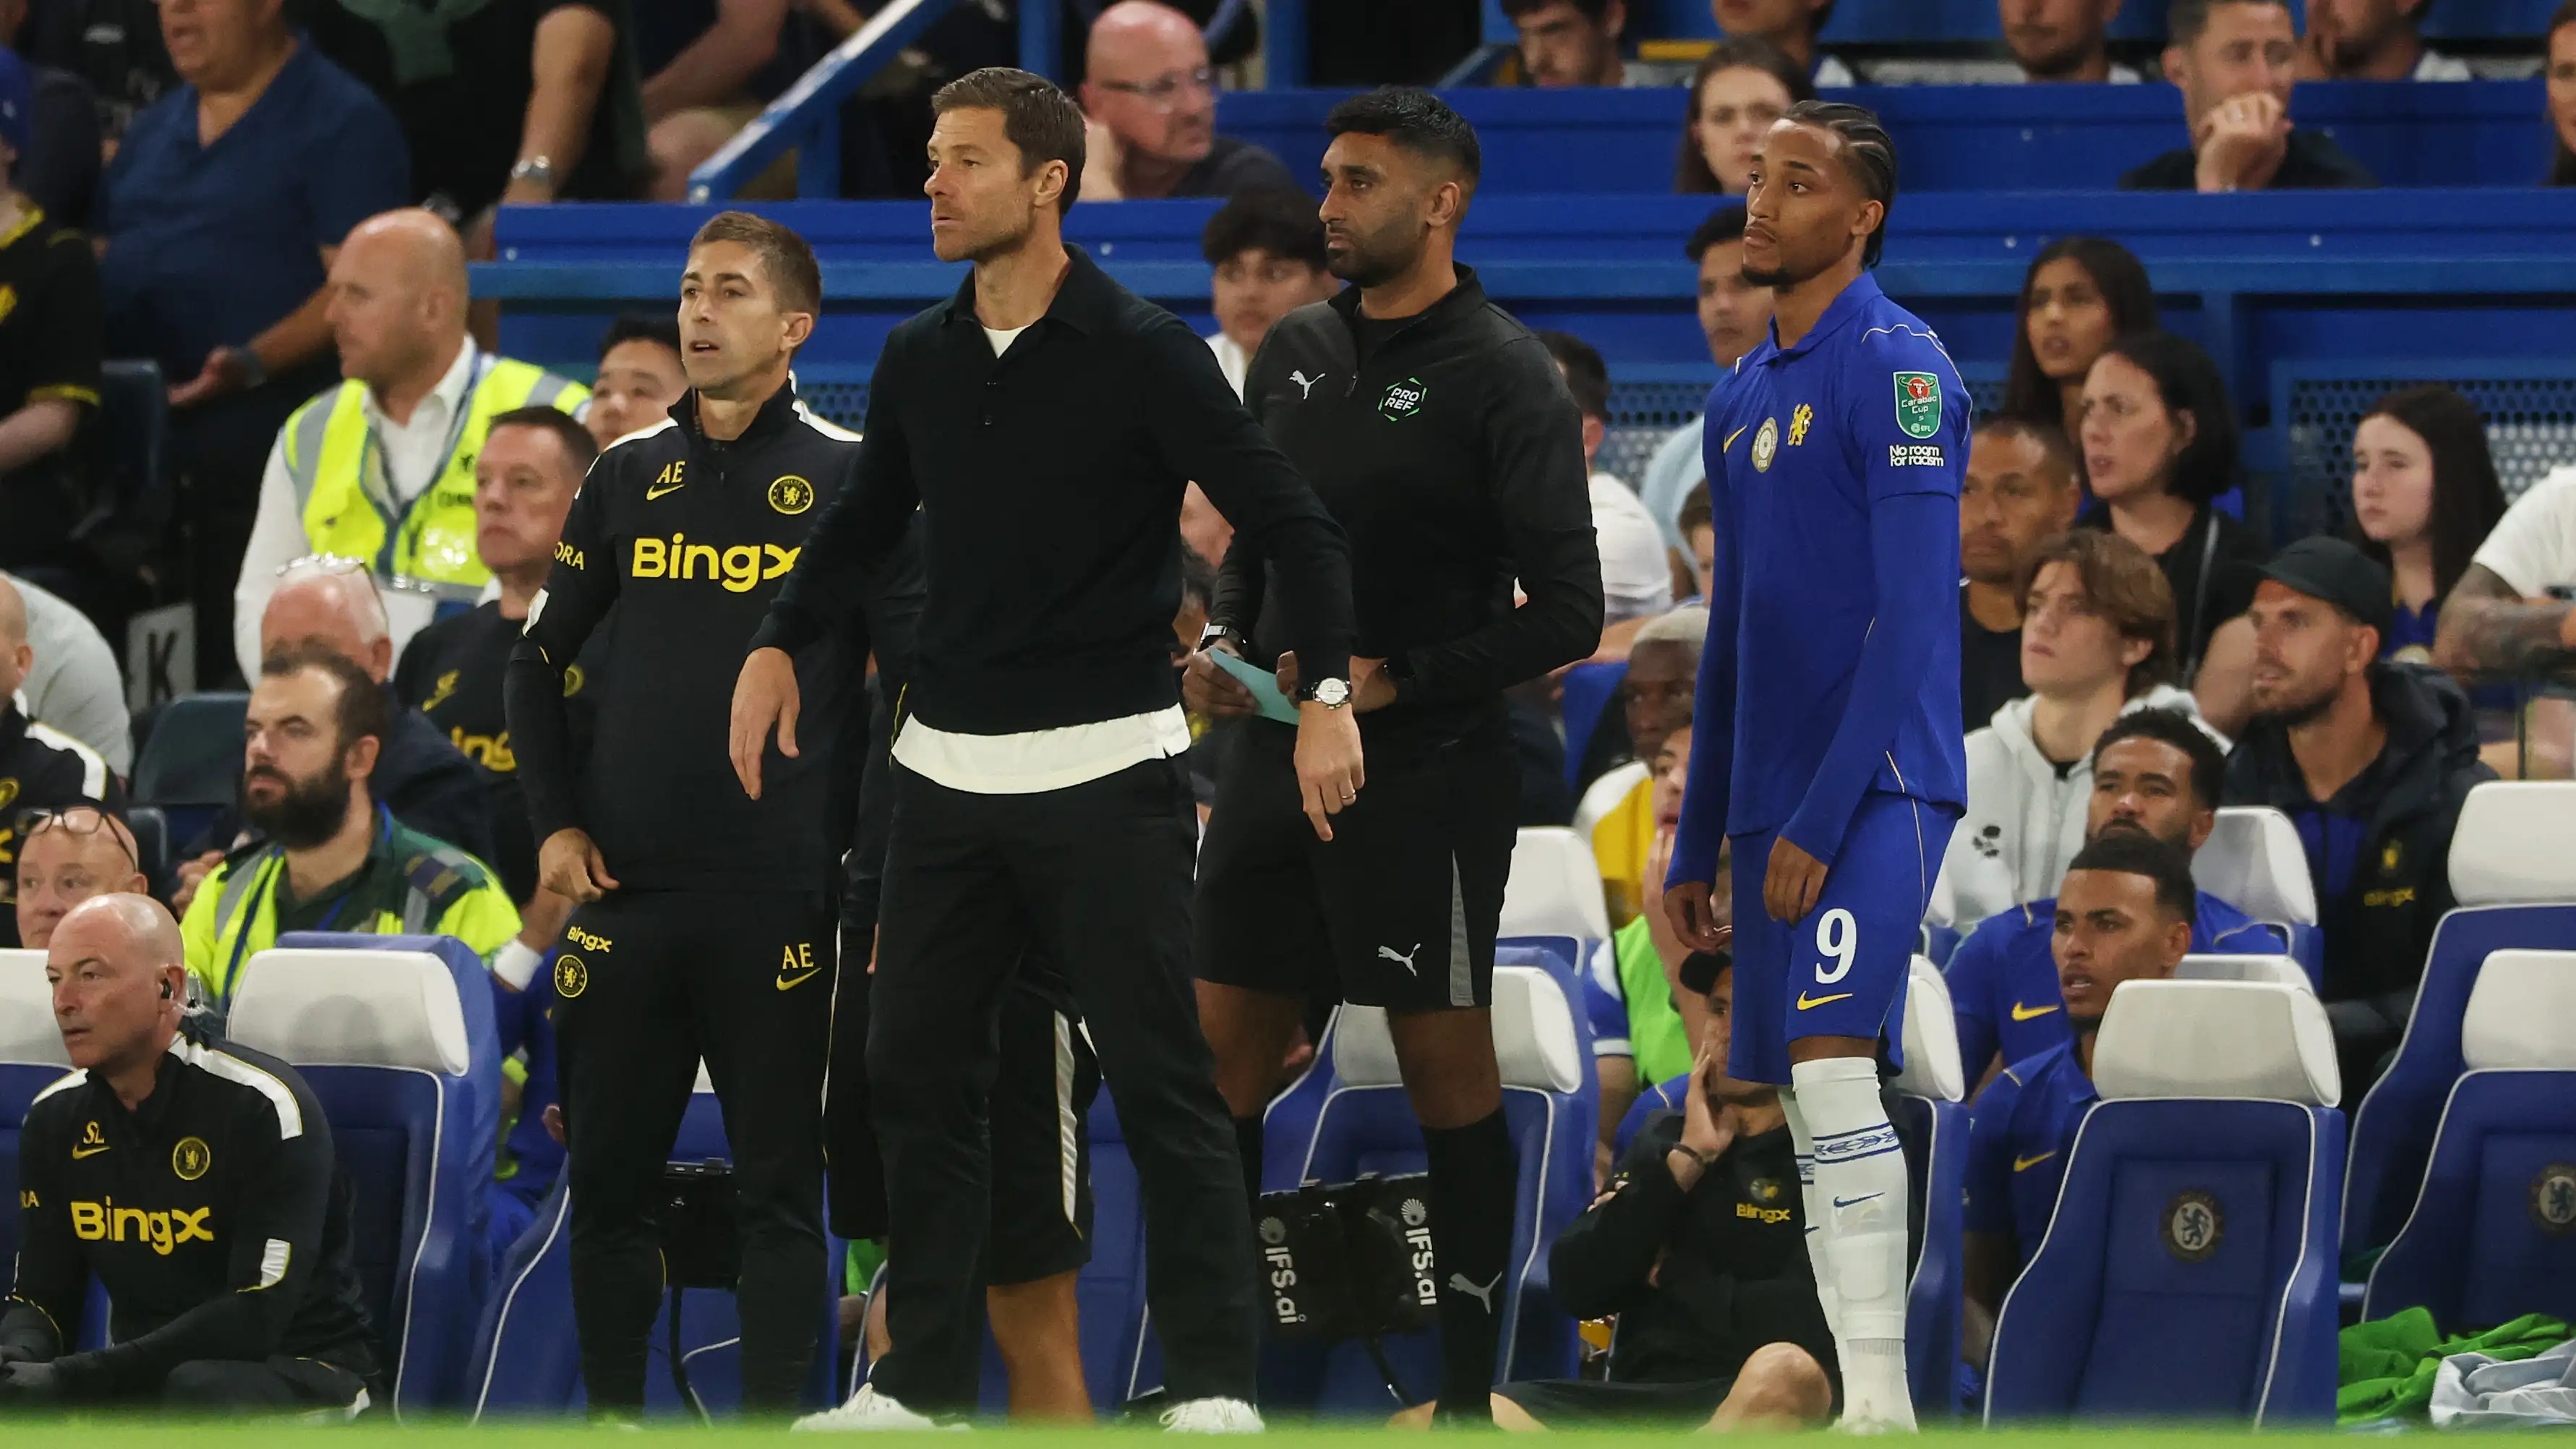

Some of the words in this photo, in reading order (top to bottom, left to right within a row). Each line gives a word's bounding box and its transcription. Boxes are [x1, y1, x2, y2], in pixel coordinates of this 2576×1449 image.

[1390, 387, 1420, 401] PRO
[1901, 396, 1937, 408] Carabao
[1385, 397, 1415, 411] REF
[1912, 405, 1928, 414] Cup
[1889, 445, 1907, 457] No
[1909, 445, 1940, 456] room
[1890, 456, 1907, 467] for
[1909, 455, 1944, 466] racism
[656, 461, 685, 484] AE
[147, 628, 178, 707] K
[1815, 908, 1857, 984] 9
[782, 943, 814, 970] AE
[83, 1121, 105, 1145] SL
[1265, 1247, 1307, 1324] IFS.ai
